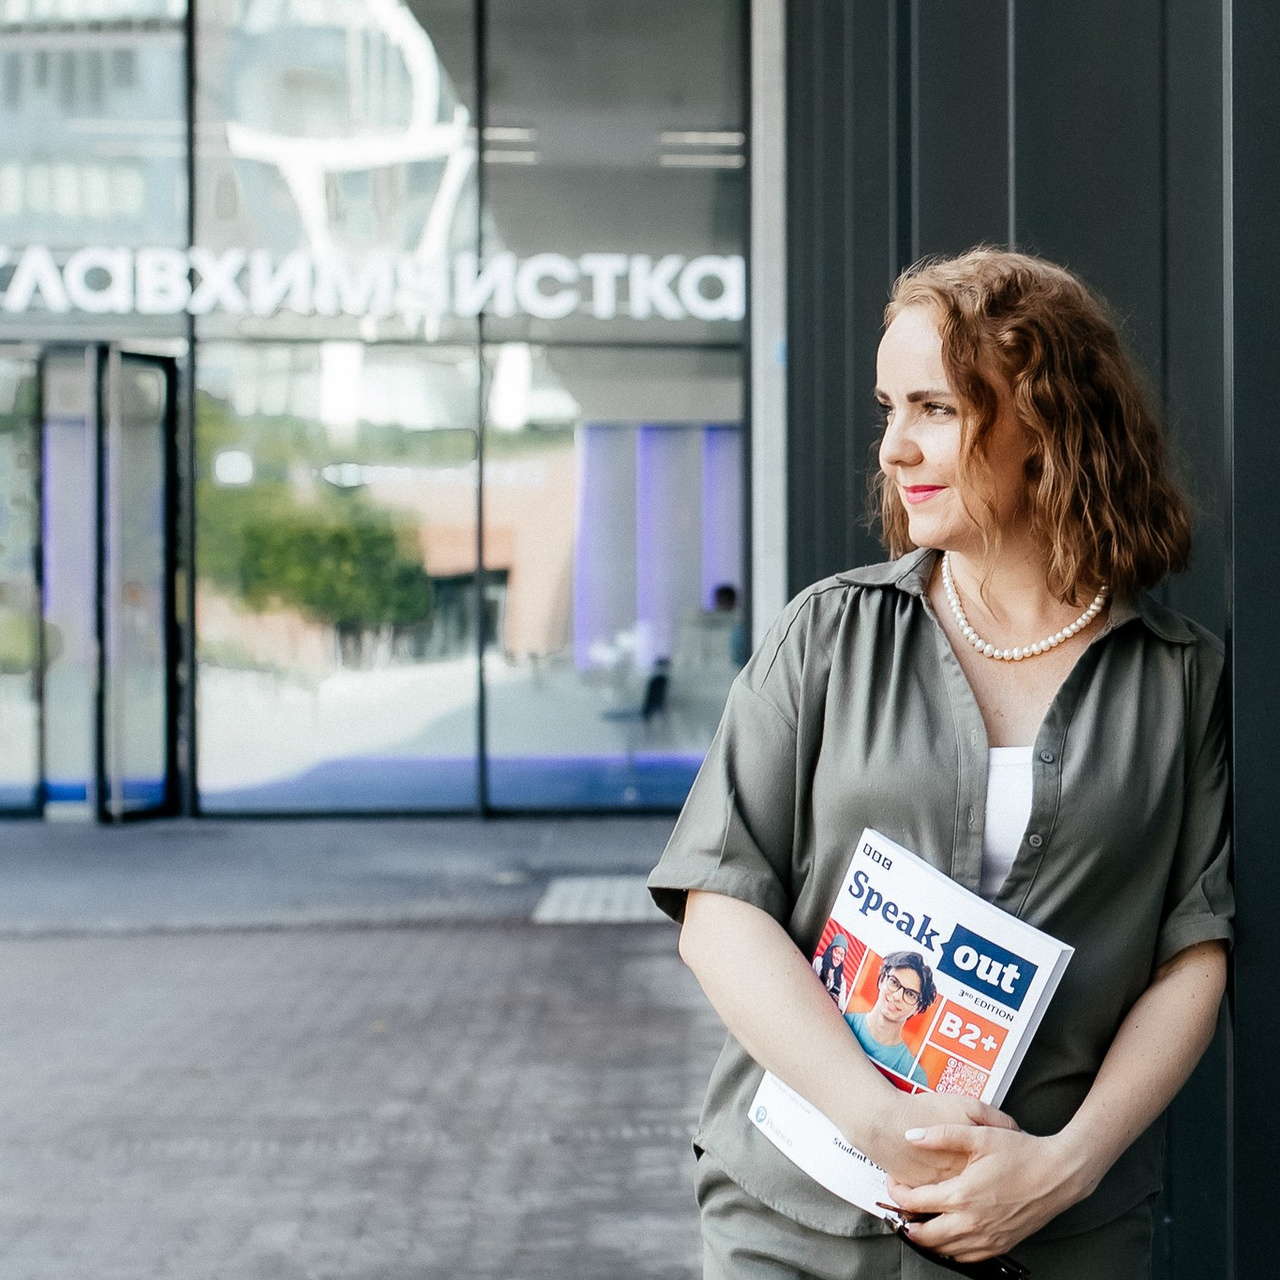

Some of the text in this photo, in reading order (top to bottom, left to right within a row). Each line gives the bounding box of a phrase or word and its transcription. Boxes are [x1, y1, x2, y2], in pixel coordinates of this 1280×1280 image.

[0, 245, 747, 320] лавхимчистка
[848, 870, 1021, 994] Speak out
[974, 997, 1014, 1022] EDITION
[938, 1010, 998, 1052] B2+
[833, 1137, 874, 1167] Students
